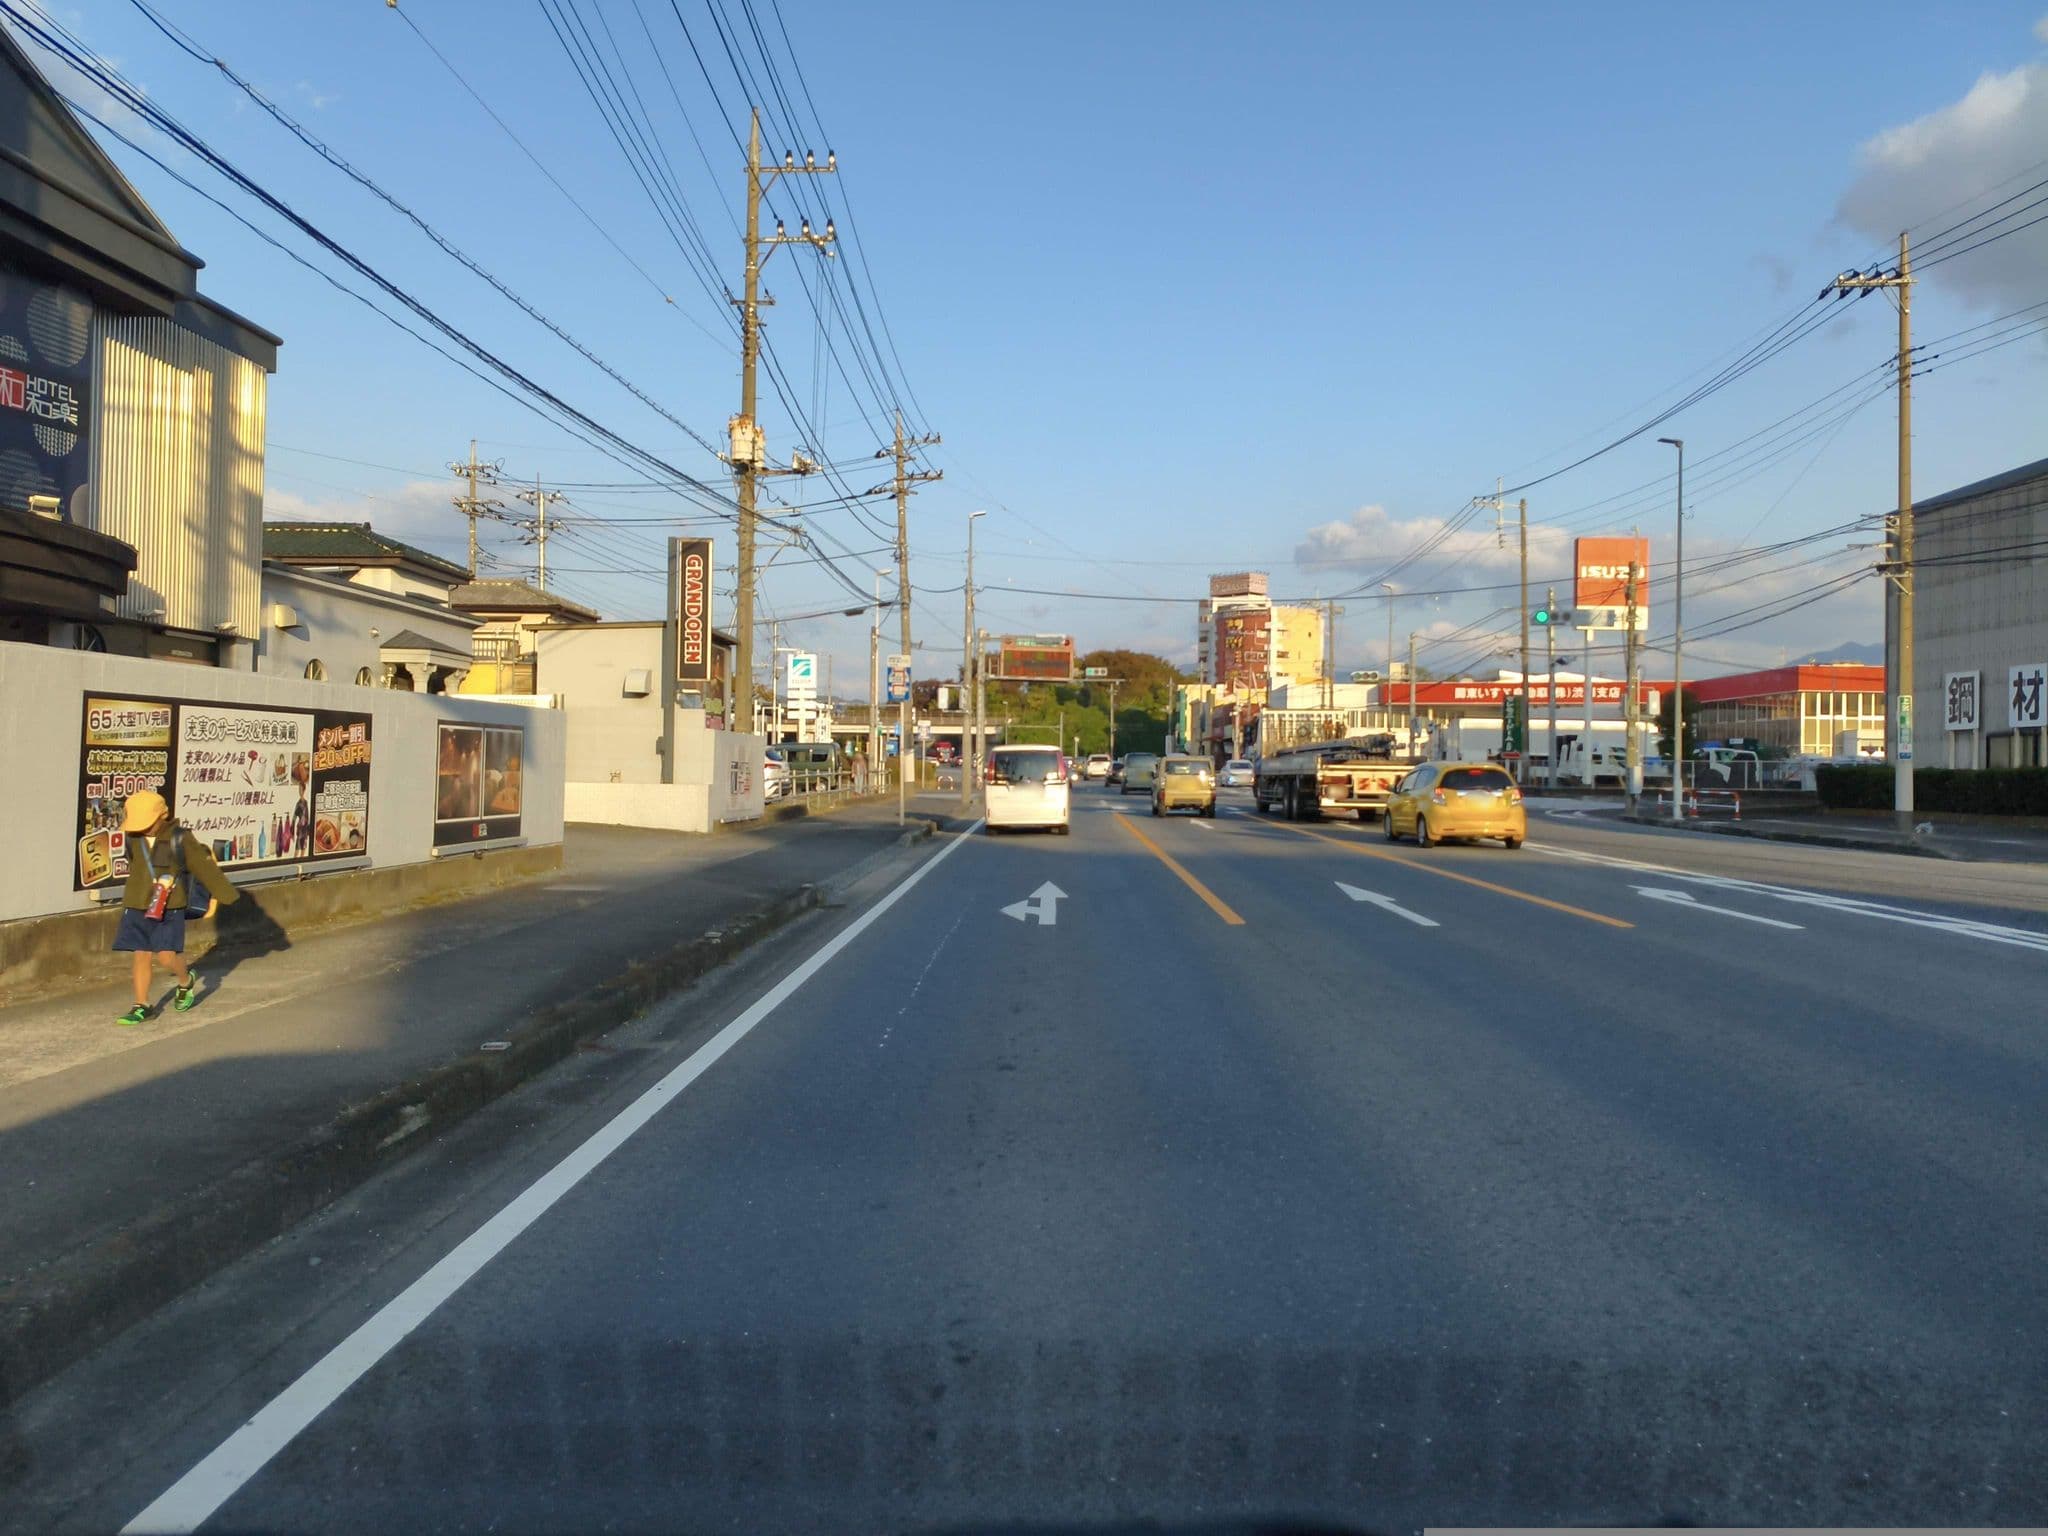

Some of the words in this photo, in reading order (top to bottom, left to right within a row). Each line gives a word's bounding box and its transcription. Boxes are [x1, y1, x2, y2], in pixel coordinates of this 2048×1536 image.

[26, 374, 79, 404] HOTEL
[183, 750, 246, 765] 充実のレンタル品
[183, 767, 232, 783] 200種類以上
[182, 790, 276, 807] フードメニュー100種類以上
